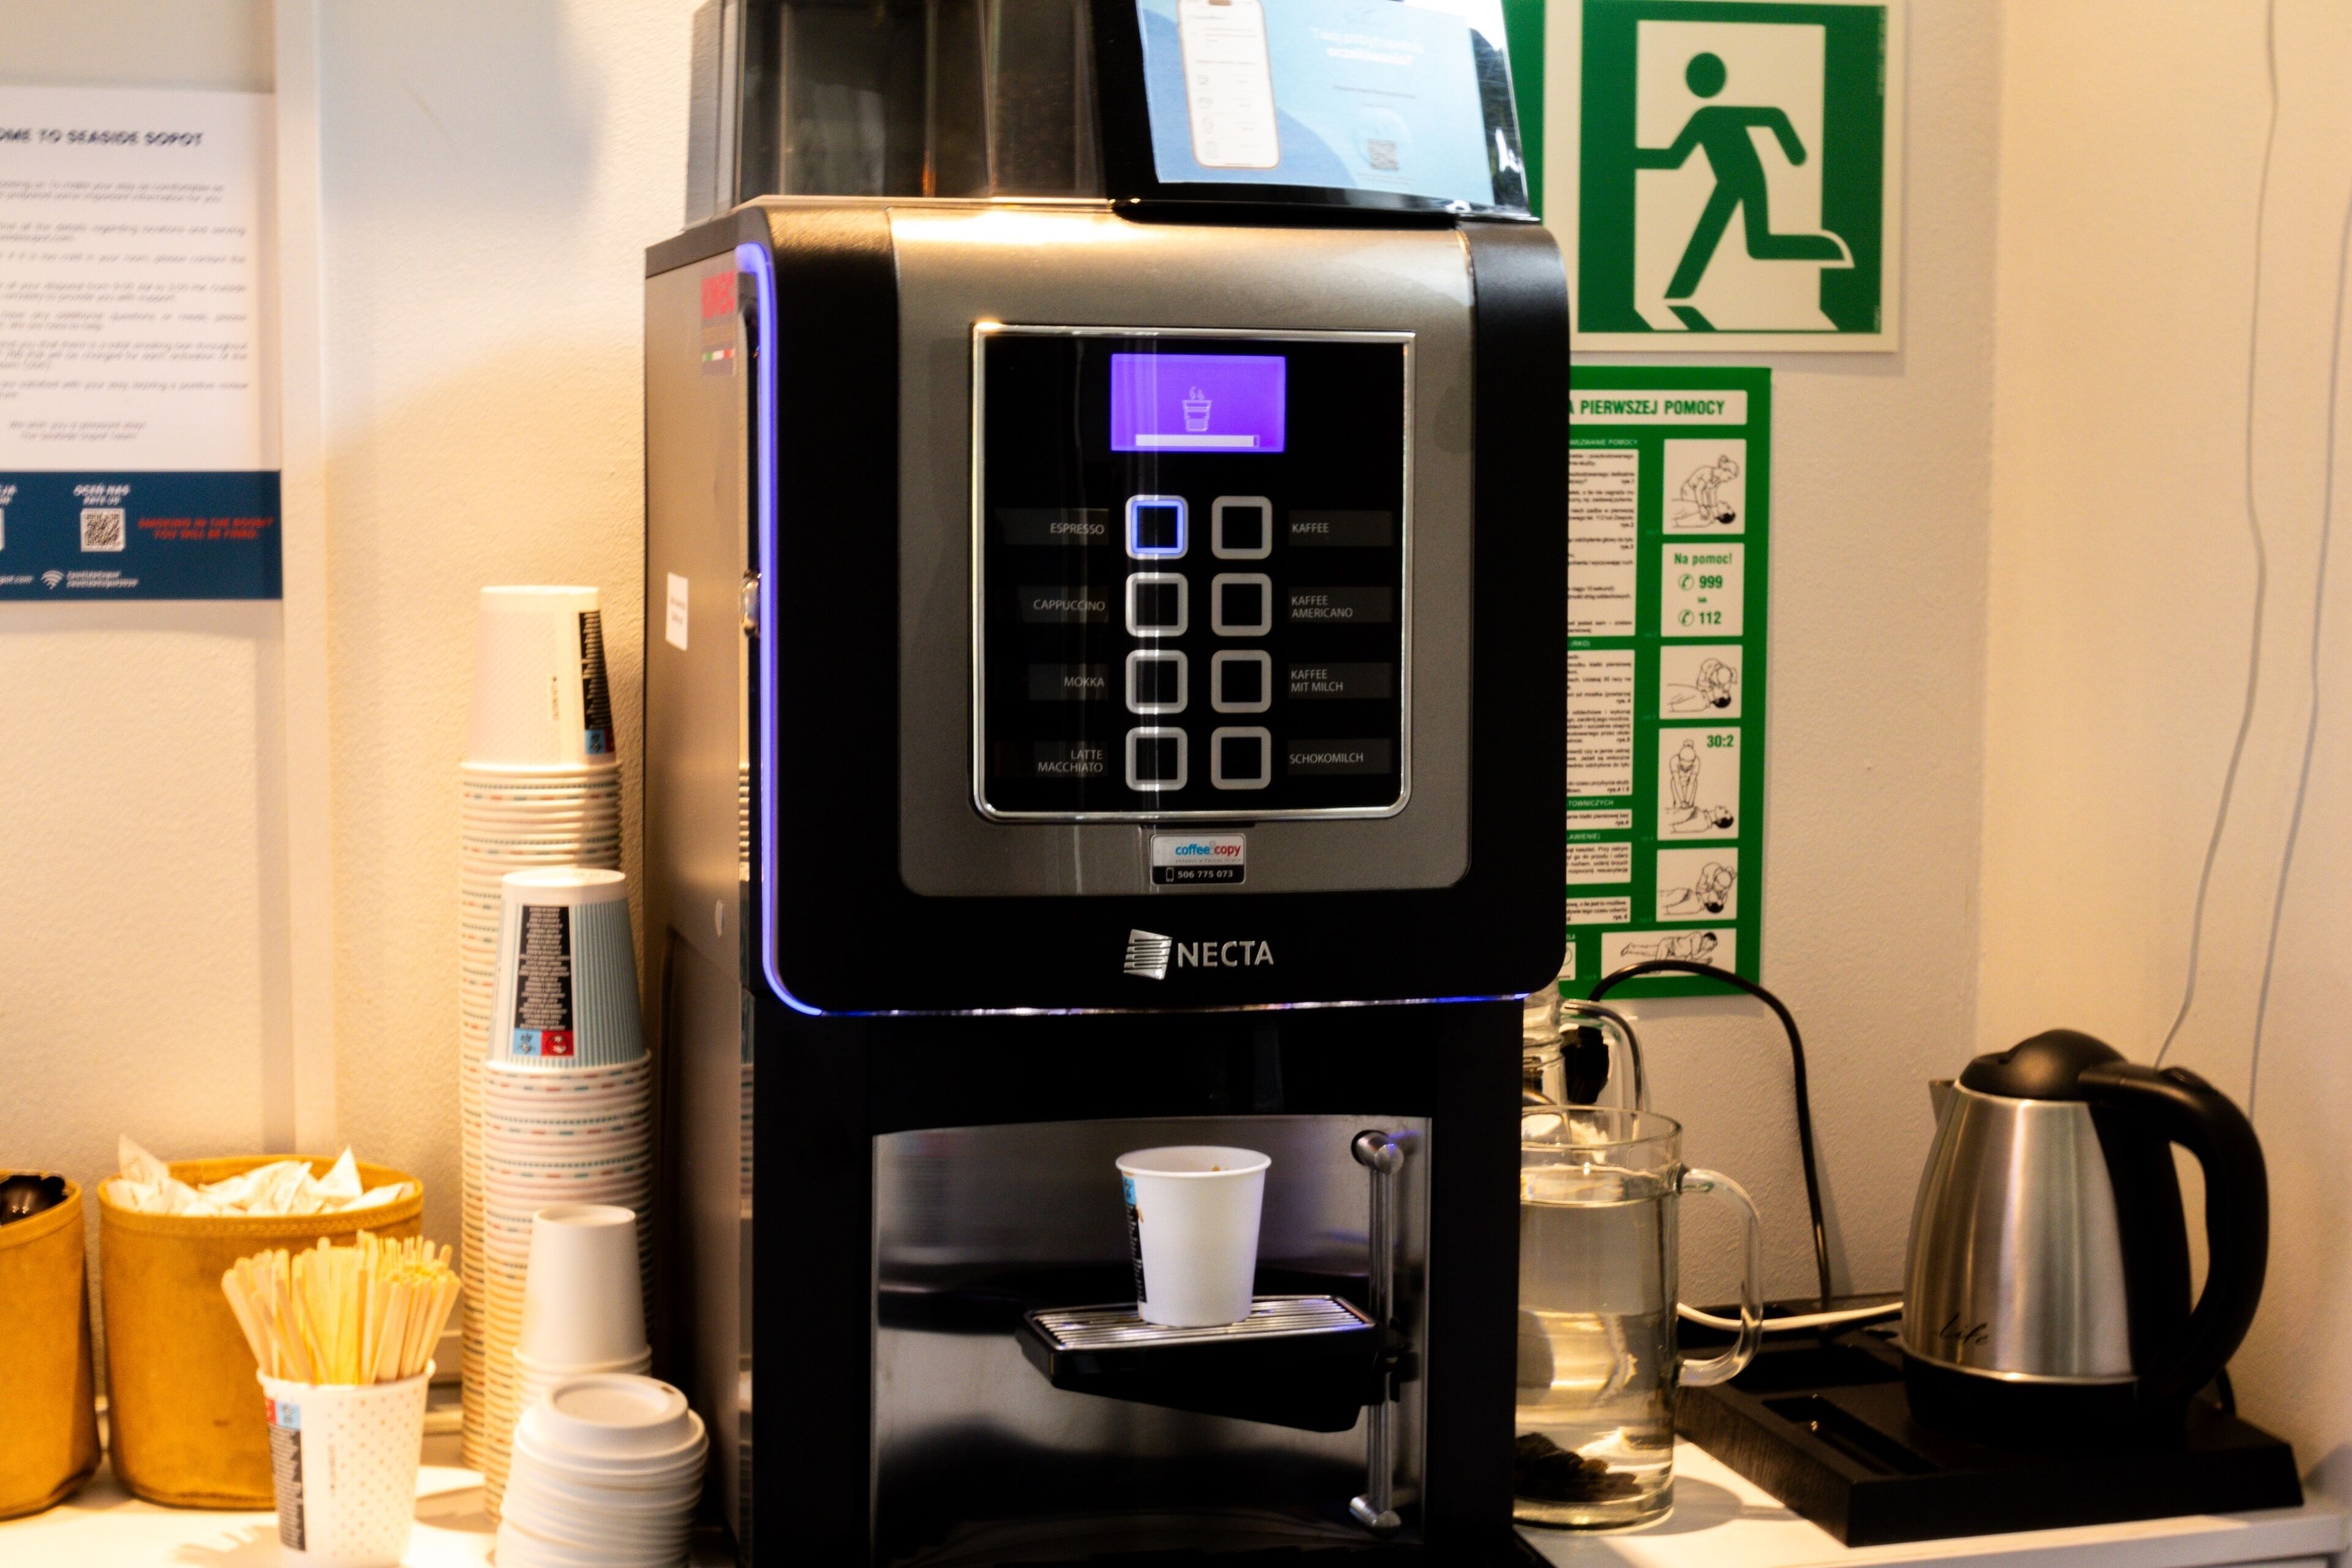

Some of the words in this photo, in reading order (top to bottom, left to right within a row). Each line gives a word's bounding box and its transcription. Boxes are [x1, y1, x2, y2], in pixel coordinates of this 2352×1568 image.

[38, 129, 60, 145] TO
[65, 129, 138, 146] SEASIDE
[145, 130, 204, 147] SOPOT
[1581, 400, 1657, 415] PIERWSZEJ
[1665, 401, 1724, 415] POMOCY
[1050, 522, 1105, 535] ESPRESSO
[1292, 522, 1330, 533] KAFFEE
[1674, 554, 1688, 564] Na
[1692, 552, 1732, 567] pomoc!
[1699, 576, 1723, 589] 999
[1033, 599, 1106, 611] CAPPUCCINO
[1291, 595, 1329, 606] KAFFEE
[1291, 607, 1354, 619] AMERICANO
[1700, 612, 1721, 625] 112
[1291, 669, 1328, 680] KAFFEE
[1063, 676, 1105, 687] MOKKA
[1291, 682, 1309, 693] MIT
[1311, 681, 1344, 692] MILCH
[1707, 735, 1733, 747] 30:2
[1071, 750, 1103, 760] LATTE
[1289, 753, 1365, 765] SCHOKOMILCH
[1038, 761, 1103, 773] MACCHIATO
[1175, 844, 1210, 855] coffee
[1214, 845, 1241, 856] copy
[1177, 941, 1275, 968] NECTA
